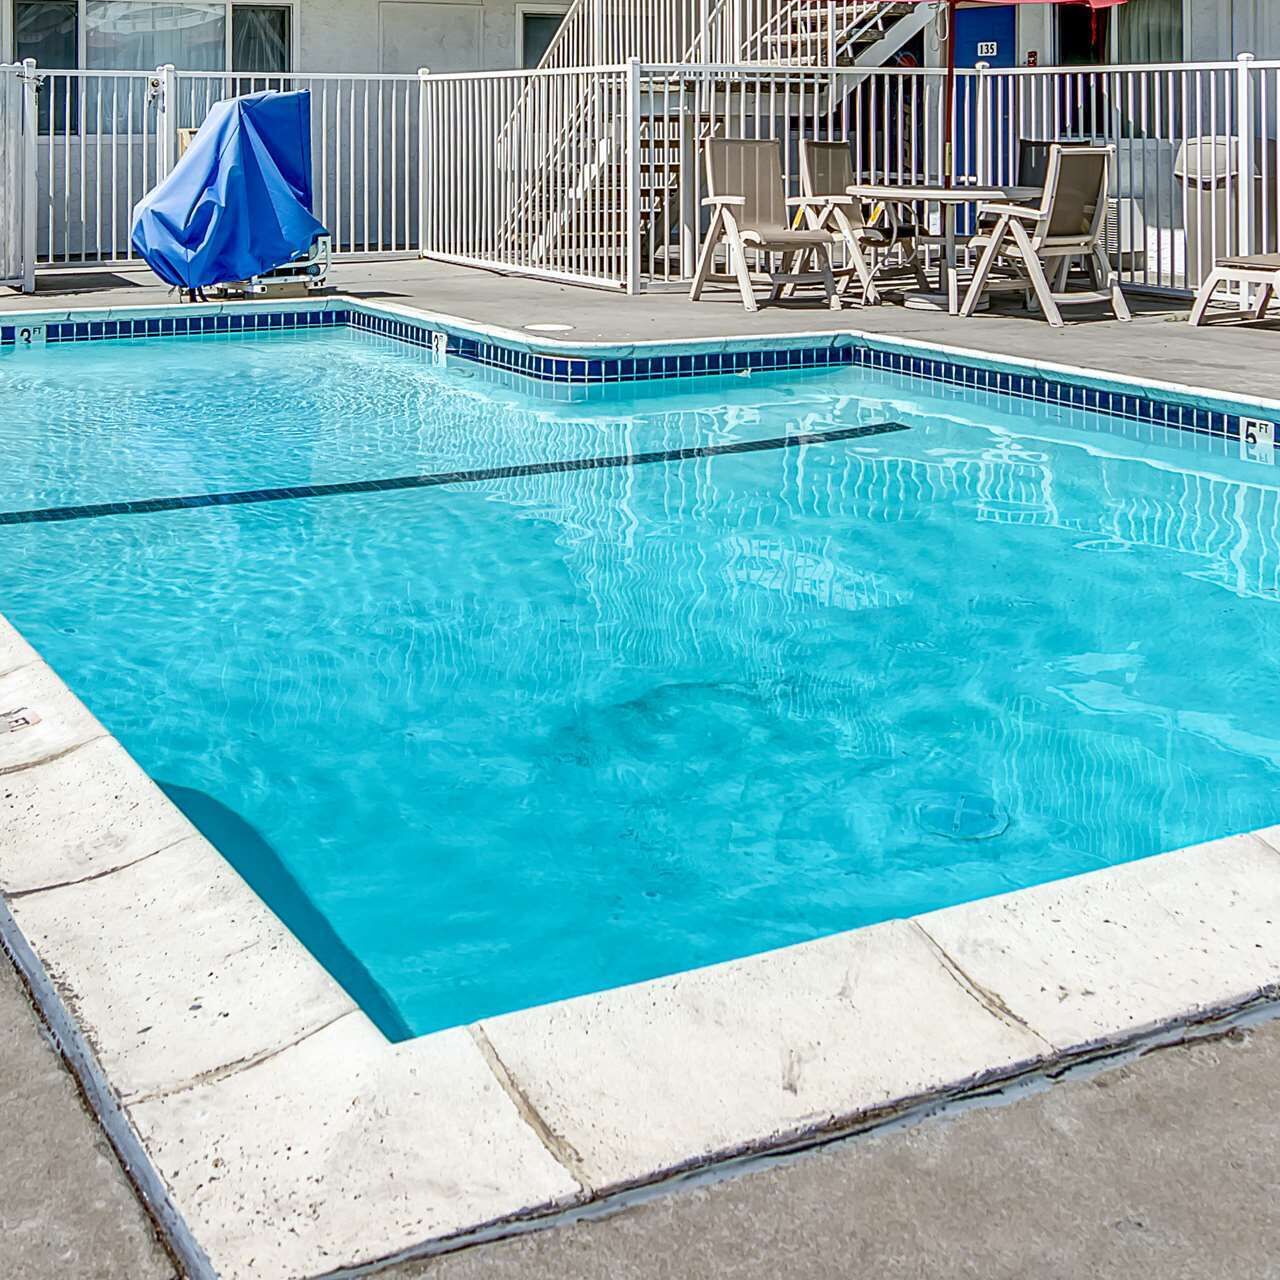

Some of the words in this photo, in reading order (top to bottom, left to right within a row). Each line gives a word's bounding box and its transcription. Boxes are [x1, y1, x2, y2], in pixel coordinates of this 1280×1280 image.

[980, 44, 994, 54] 135
[32, 326, 42, 335] FT
[1245, 421, 1257, 445] 5
[1258, 423, 1269, 434] FT
